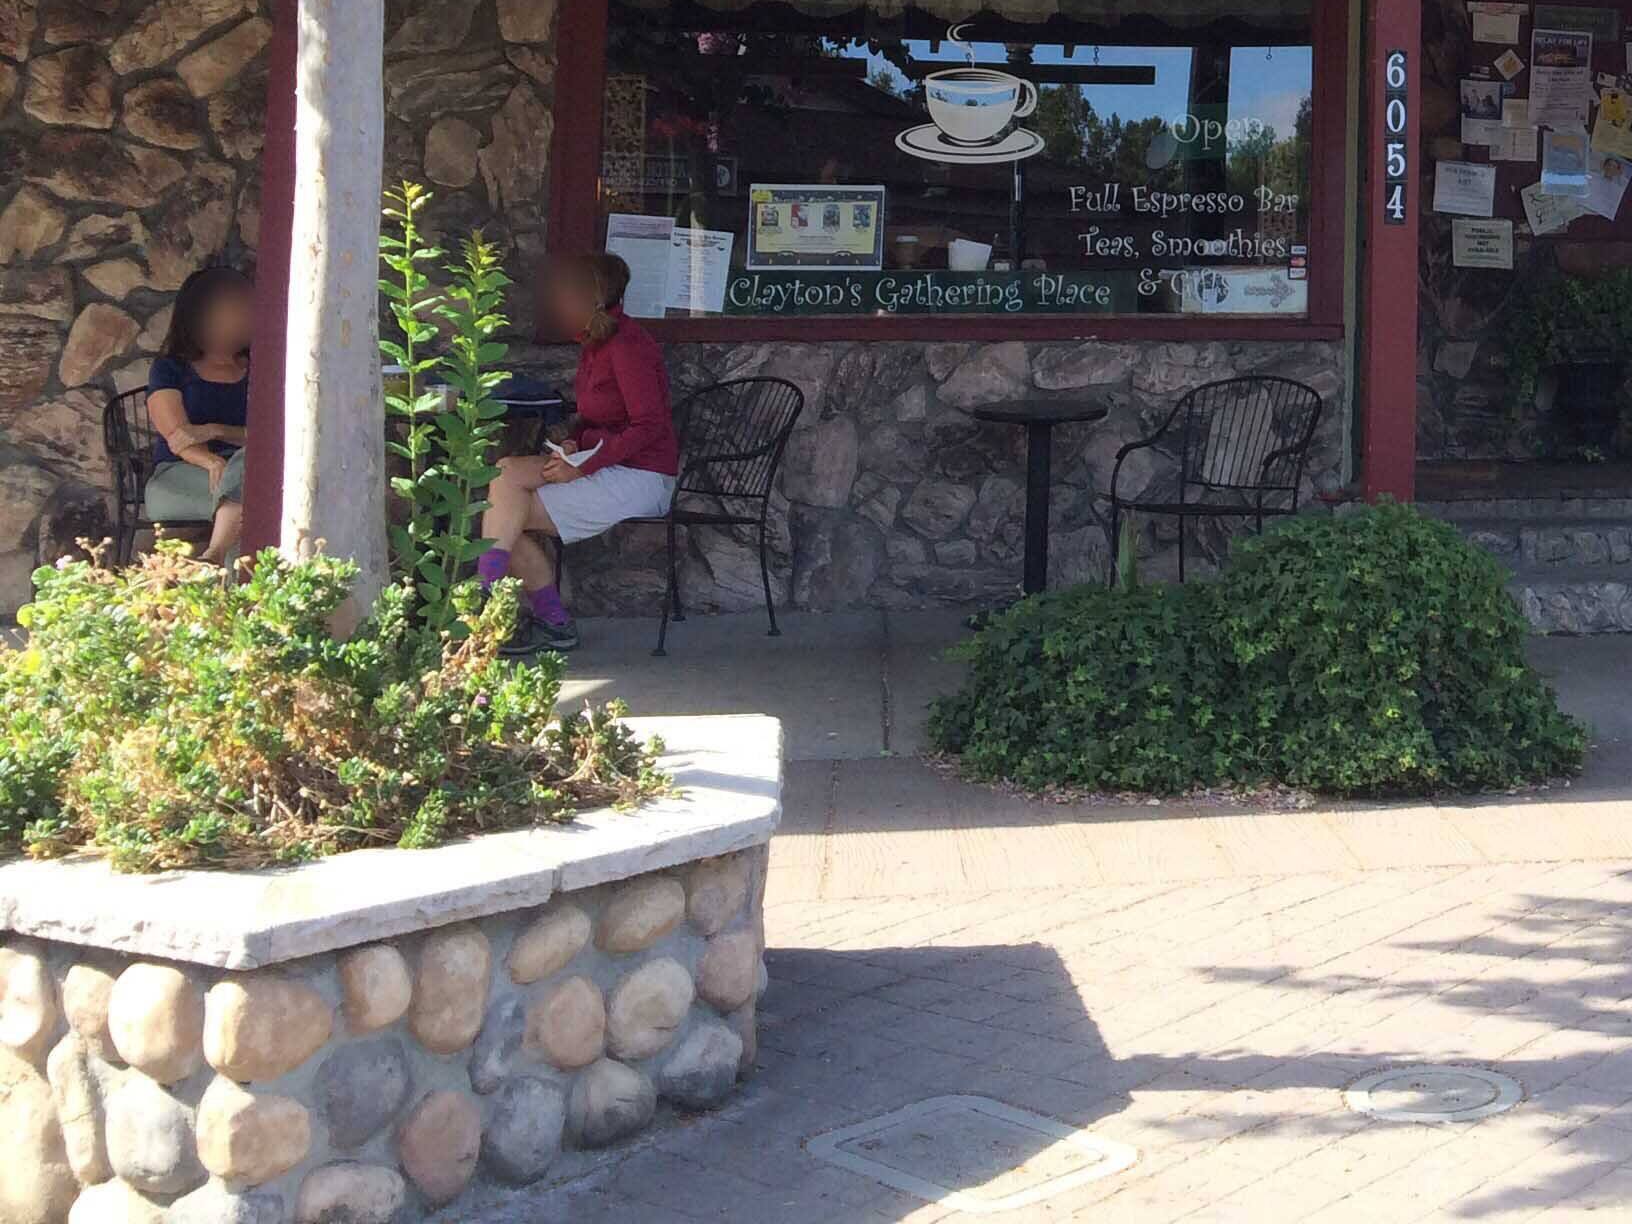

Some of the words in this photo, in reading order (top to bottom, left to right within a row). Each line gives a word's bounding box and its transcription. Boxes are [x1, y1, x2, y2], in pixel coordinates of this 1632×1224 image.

[1169, 112, 1265, 151] Open
[1384, 51, 1407, 220] 6054
[1069, 182, 1122, 214] Full
[1132, 185, 1245, 219] Espresso
[1254, 185, 1299, 214] Bar
[1078, 227, 1140, 259] Teas,
[1151, 226, 1288, 258] Smoothies
[728, 275, 862, 307] Clayton's
[875, 276, 1025, 312] Gathering
[1033, 275, 1112, 307] Place
[1137, 267, 1162, 296] &
